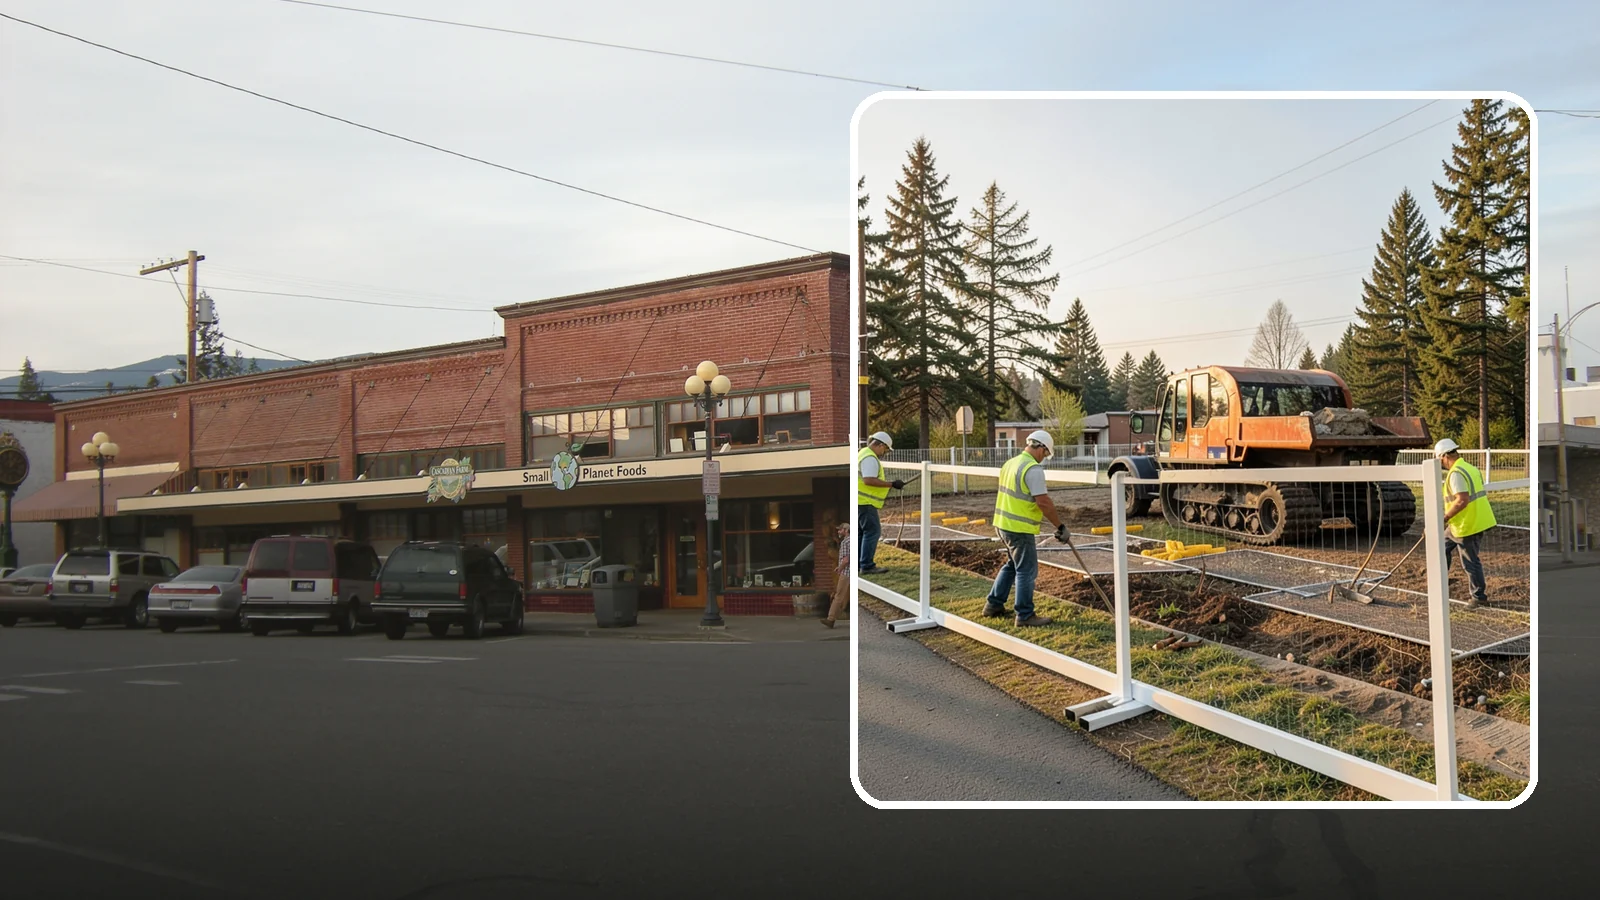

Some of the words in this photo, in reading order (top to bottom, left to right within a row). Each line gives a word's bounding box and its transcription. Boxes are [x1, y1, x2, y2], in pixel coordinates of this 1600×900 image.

[431, 467, 455, 476] CASCADIAN
[456, 466, 469, 475] FARM
[523, 471, 548, 483] Small
[583, 468, 614, 479] Planet
[617, 464, 647, 476] Foods
